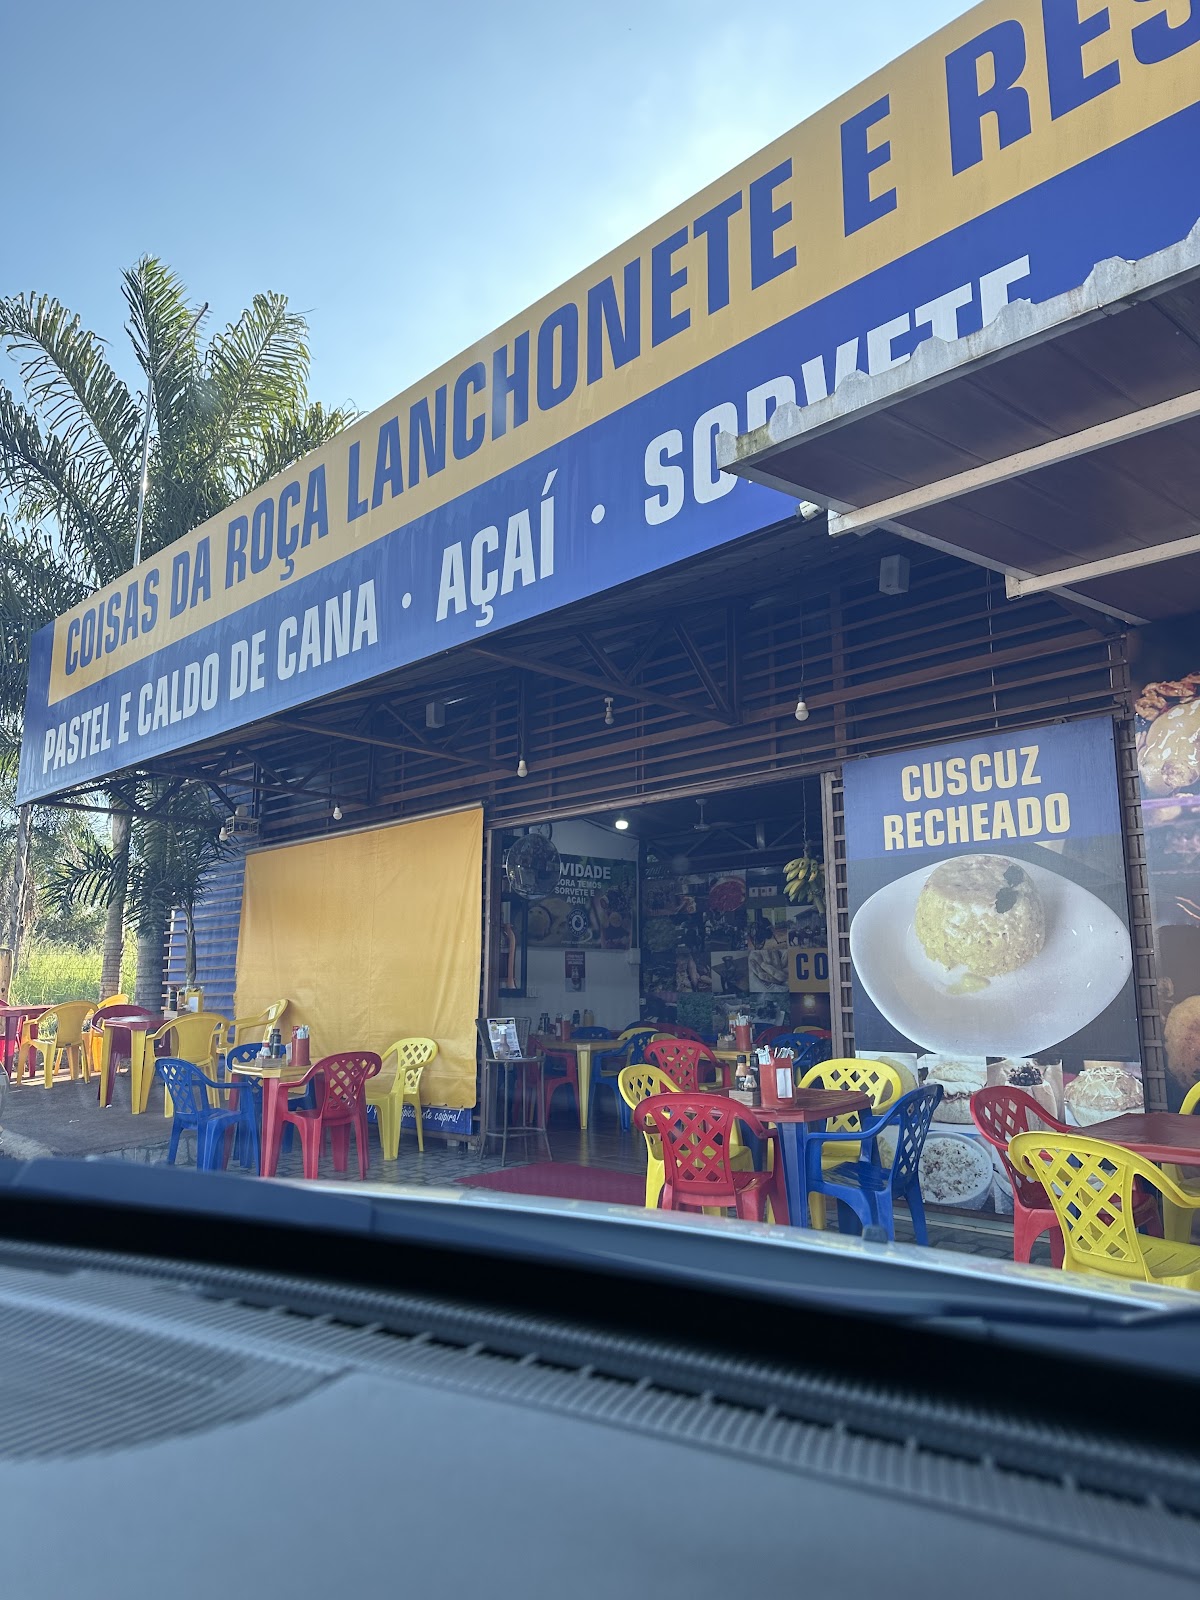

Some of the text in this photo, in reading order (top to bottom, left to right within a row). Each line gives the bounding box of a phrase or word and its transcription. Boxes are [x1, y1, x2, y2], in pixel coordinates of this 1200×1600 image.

[65, 568, 160, 676] COISAS
[169, 535, 213, 620] DA
[225, 463, 329, 581] ROÇA
[347, 158, 798, 523] LANCHONETE
[840, 94, 898, 238] E
[42, 711, 111, 775] PASTEL
[118, 707, 130, 743] E
[137, 651, 220, 736] CALDO
[229, 636, 266, 700] DE
[277, 578, 379, 682] CANA
[436, 468, 559, 628] AÇAÍ
[901, 744, 1042, 802] CUSCUZ
[883, 792, 1071, 851] RECHEADO
[560, 862, 611, 880] VIDADE
[577, 880, 602, 889] TEMOS
[554, 886, 595, 897] SORVETE E
[434, 1108, 462, 1127] caipira!
